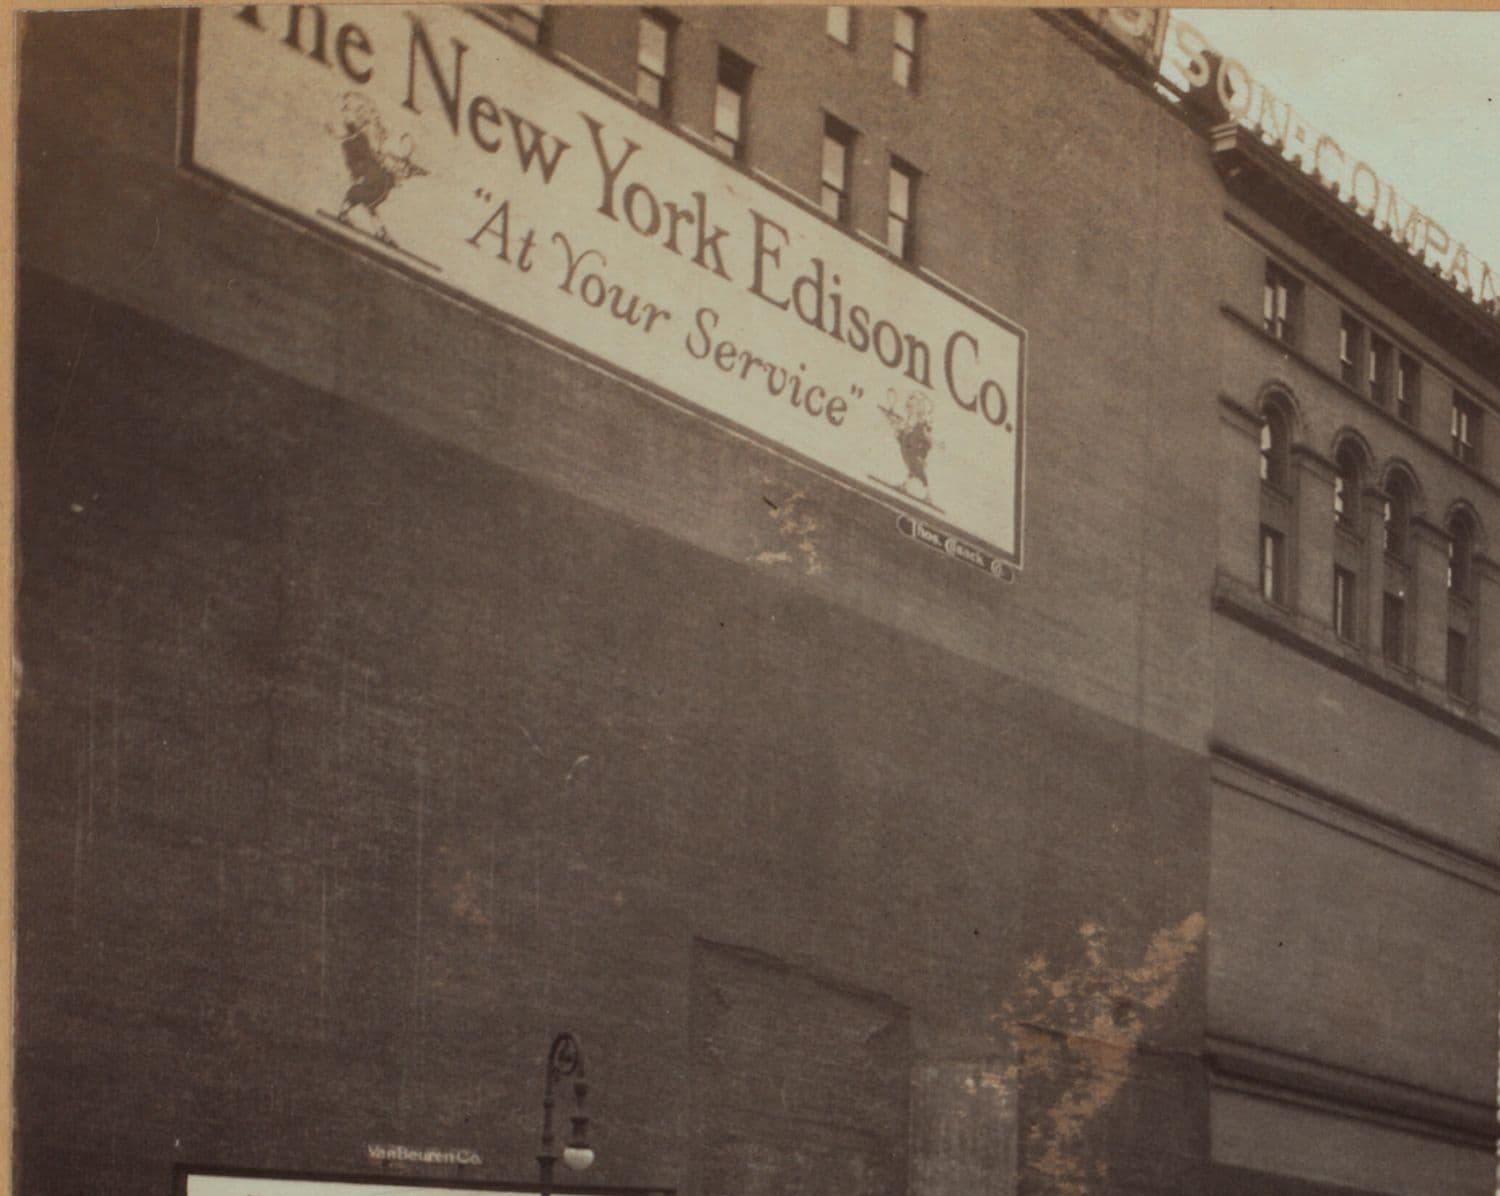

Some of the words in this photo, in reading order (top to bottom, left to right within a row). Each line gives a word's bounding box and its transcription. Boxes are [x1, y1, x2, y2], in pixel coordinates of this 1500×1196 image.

[401, 10, 572, 184] New
[579, 112, 733, 282] York
[747, 208, 934, 390] Edison
[944, 330, 1013, 433] Co.
[552, 232, 671, 333] Your
